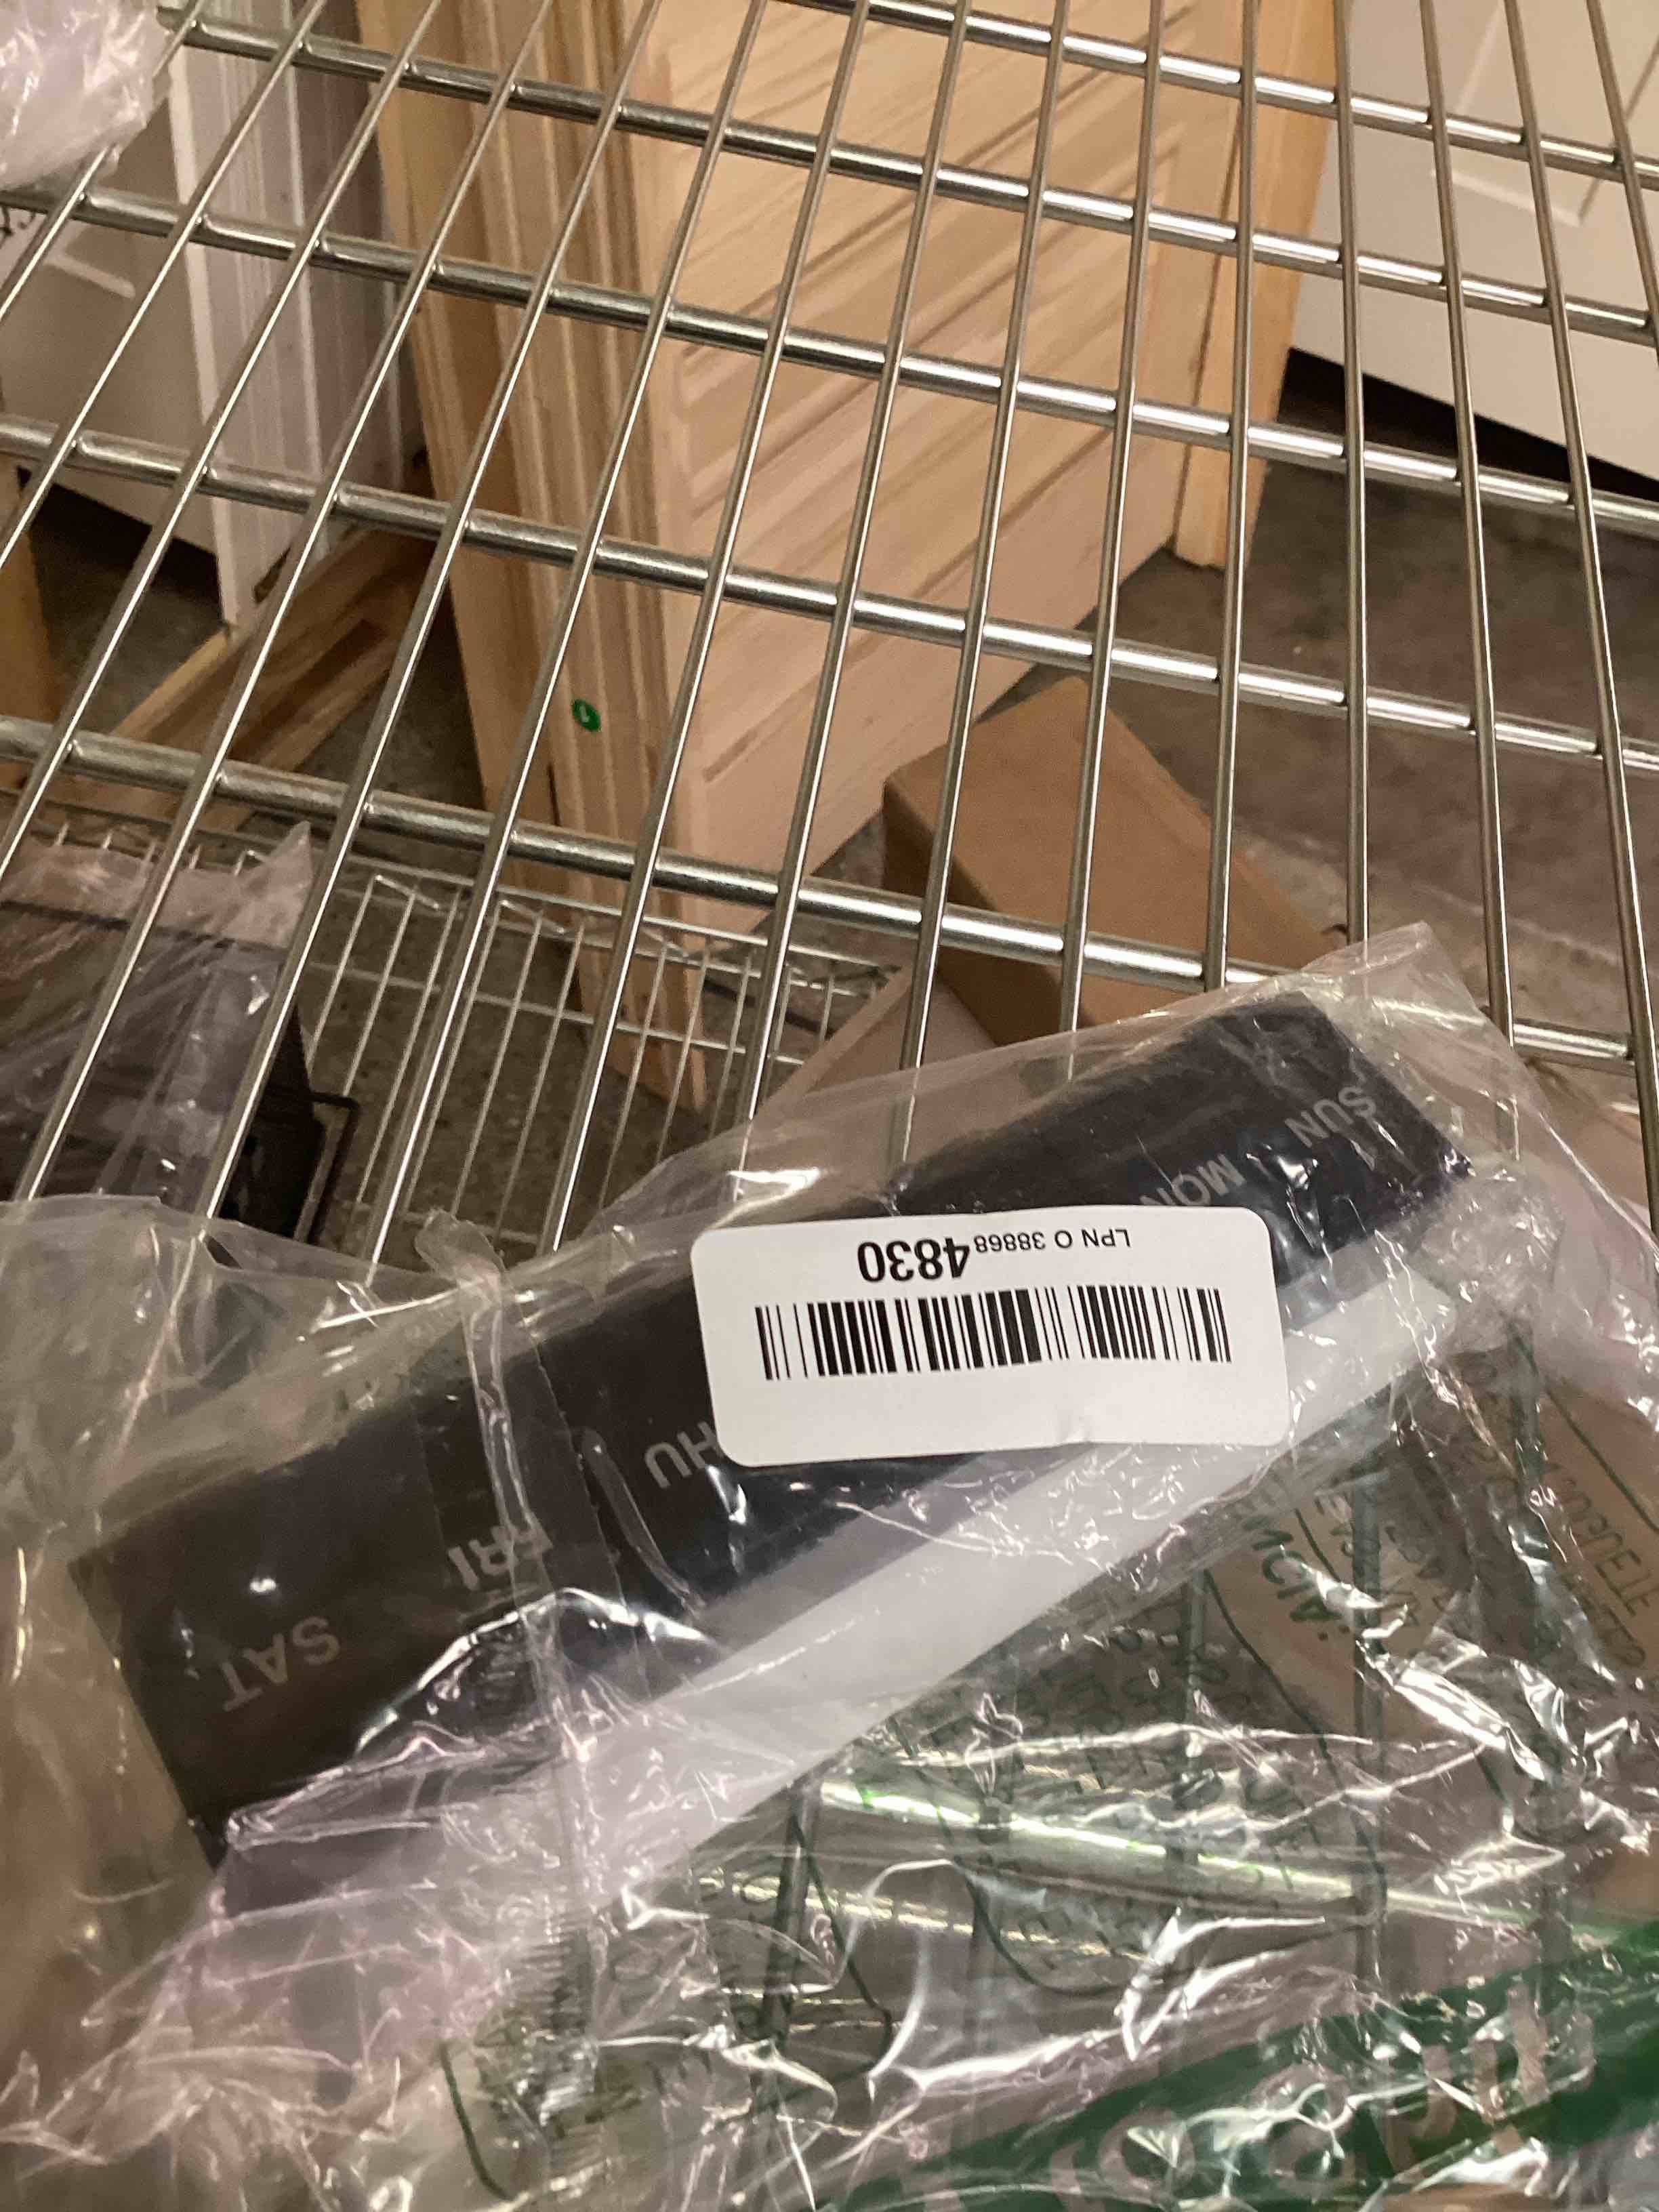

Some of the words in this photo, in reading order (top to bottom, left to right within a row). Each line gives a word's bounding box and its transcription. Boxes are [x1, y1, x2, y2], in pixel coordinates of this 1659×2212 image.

[1286, 1086, 1376, 1147] SUN
[857, 1237, 971, 1284] 4830
[973, 1231, 1046, 1254] 38868
[1082, 1228, 1132, 1248] LPN
[644, 1421, 724, 1489] HU
[448, 1525, 553, 1591] FRI
[219, 1616, 340, 1711] SAT
